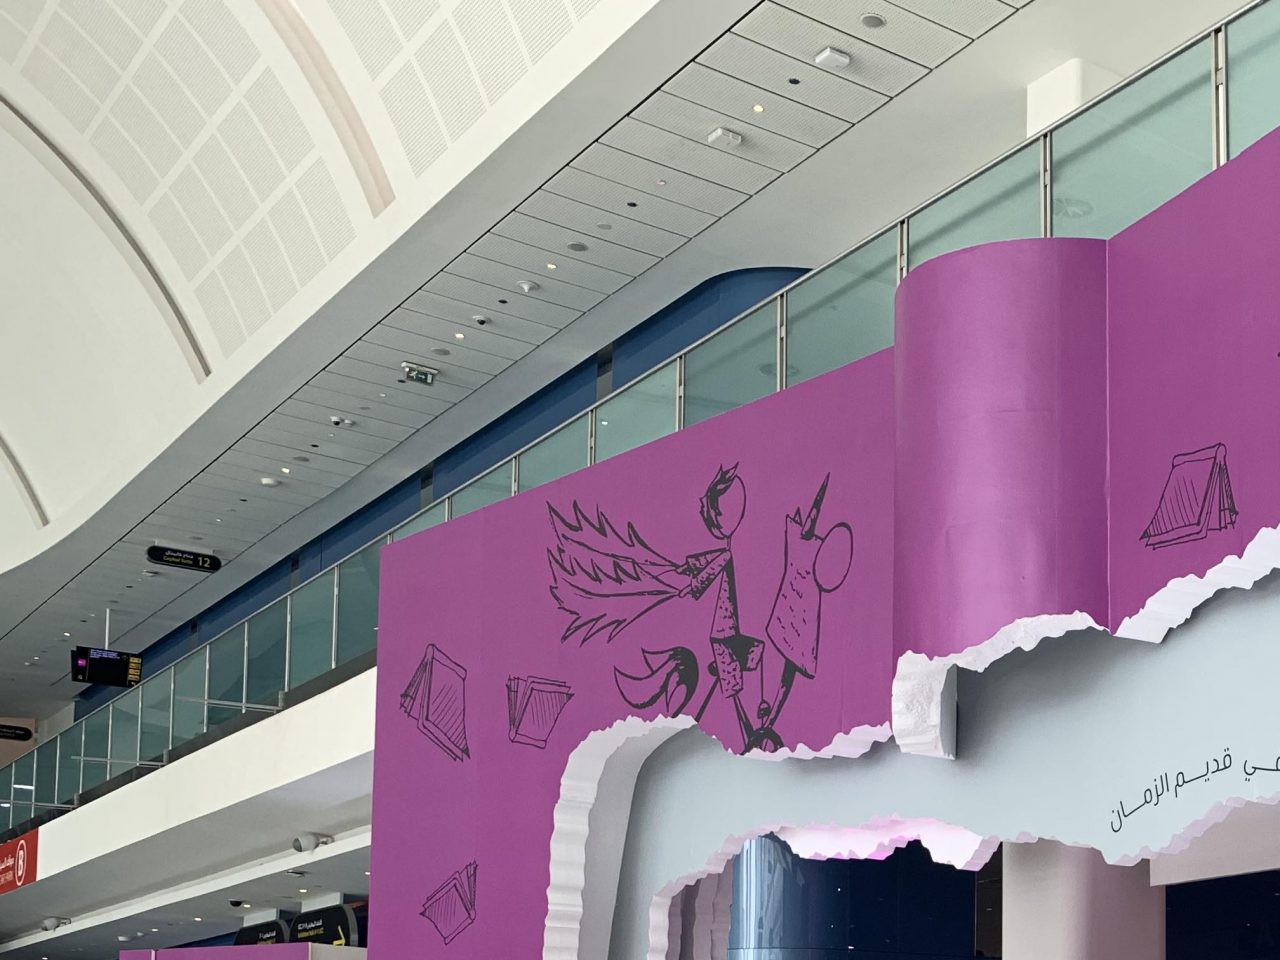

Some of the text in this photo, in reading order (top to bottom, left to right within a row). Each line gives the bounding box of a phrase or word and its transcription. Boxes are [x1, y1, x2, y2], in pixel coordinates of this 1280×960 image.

[198, 557, 211, 568] 12
[1174, 748, 1232, 797] قديم
[1111, 773, 1170, 833] الزمان
[18, 850, 24, 877] B
